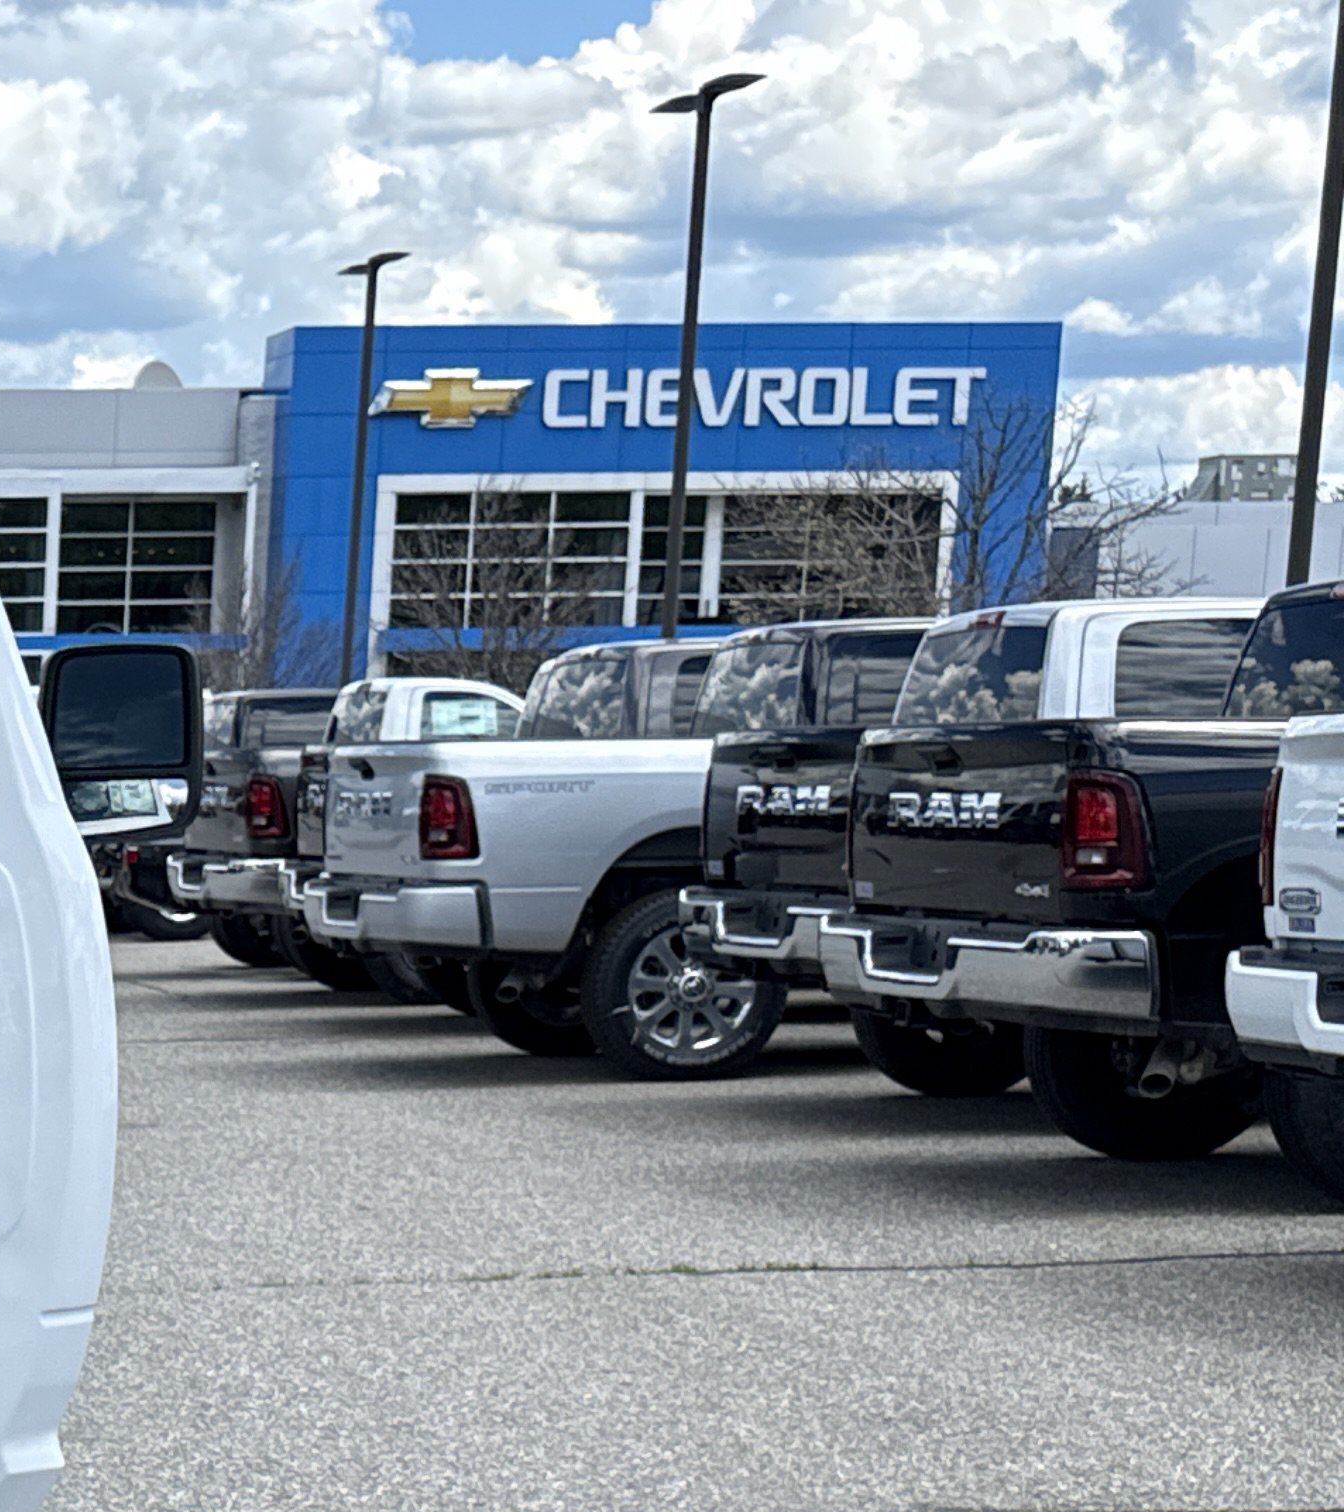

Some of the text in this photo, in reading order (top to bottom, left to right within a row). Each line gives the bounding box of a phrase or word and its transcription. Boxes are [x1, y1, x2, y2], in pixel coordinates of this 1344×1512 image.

[542, 366, 987, 428] CHEVROLET
[736, 785, 832, 816] RAM
[886, 792, 1003, 829] RAM
